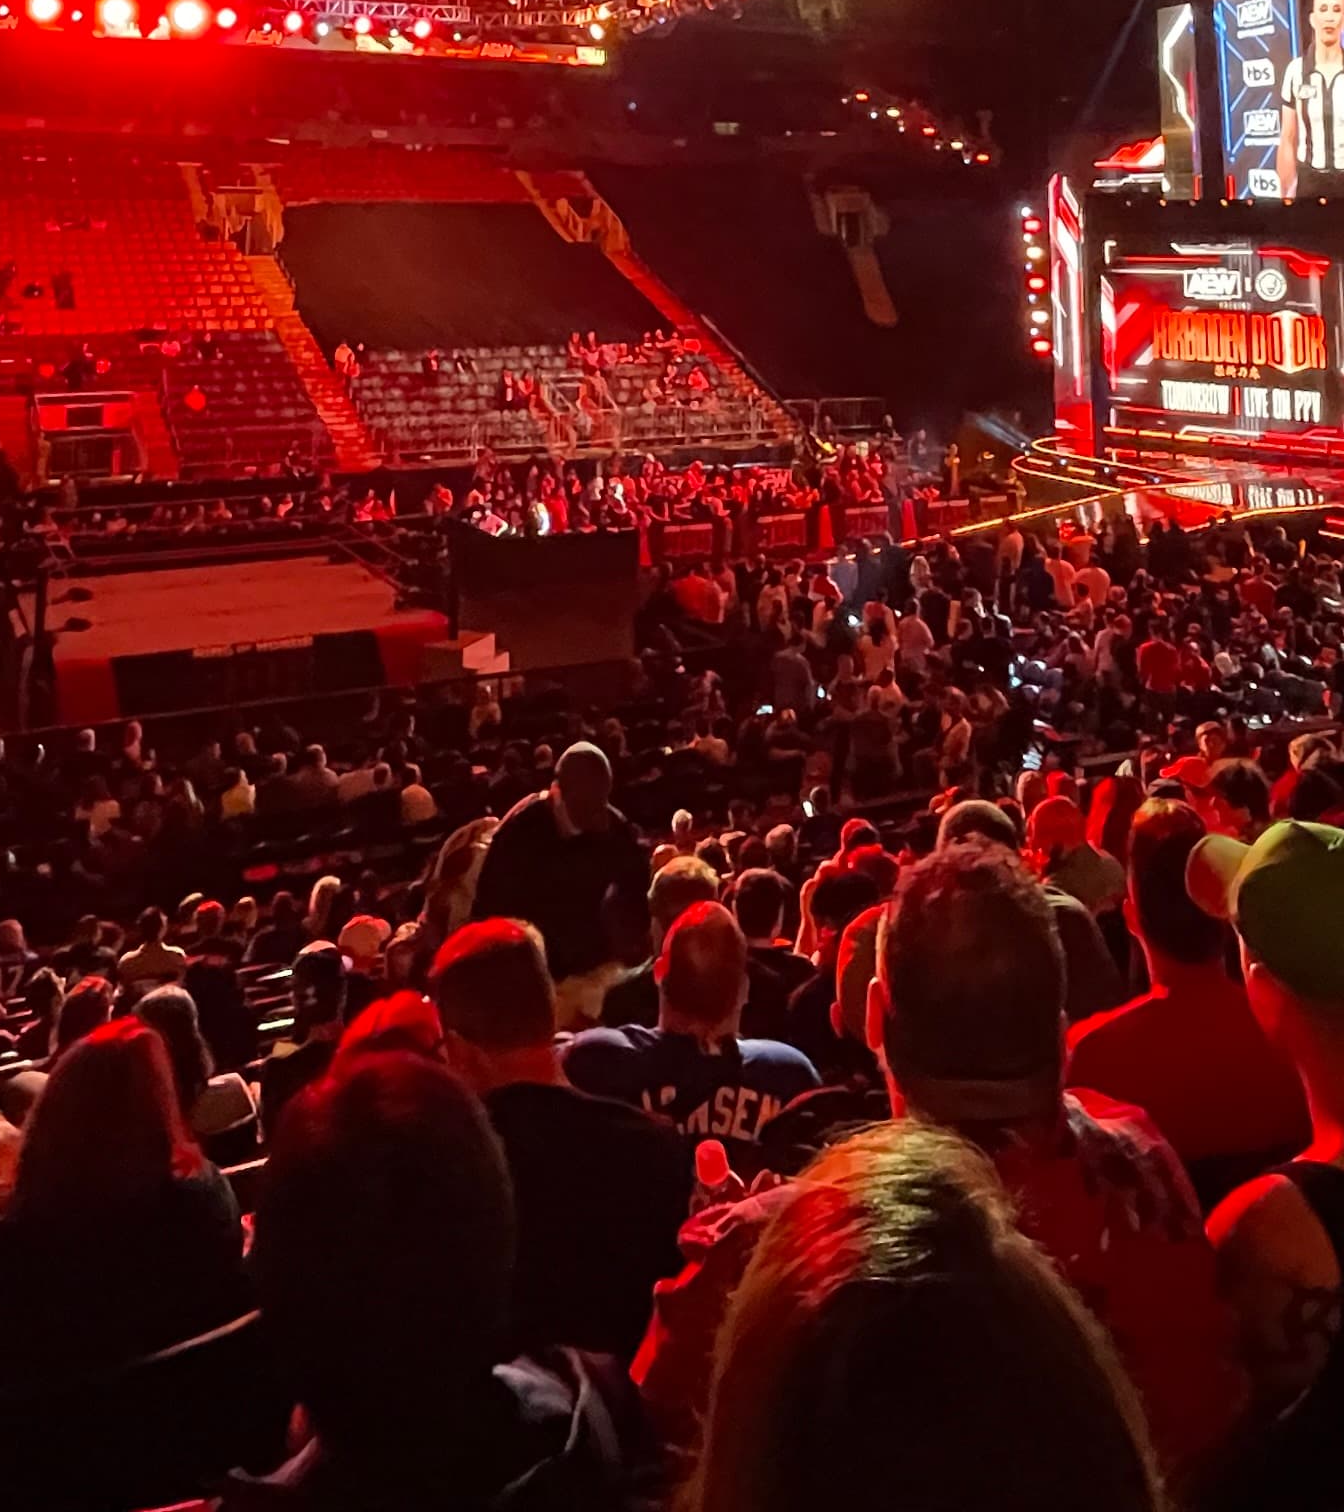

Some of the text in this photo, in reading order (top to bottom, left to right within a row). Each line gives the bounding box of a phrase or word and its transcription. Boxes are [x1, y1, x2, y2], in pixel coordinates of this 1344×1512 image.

[1247, 65, 1270, 81] tbs
[1253, 175, 1277, 192] tbs
[1188, 273, 1237, 296] AEW
[1152, 311, 1327, 373] FORBIDDEN DOOR
[1161, 380, 1321, 423] TOMORROW LIVE ON PPV
